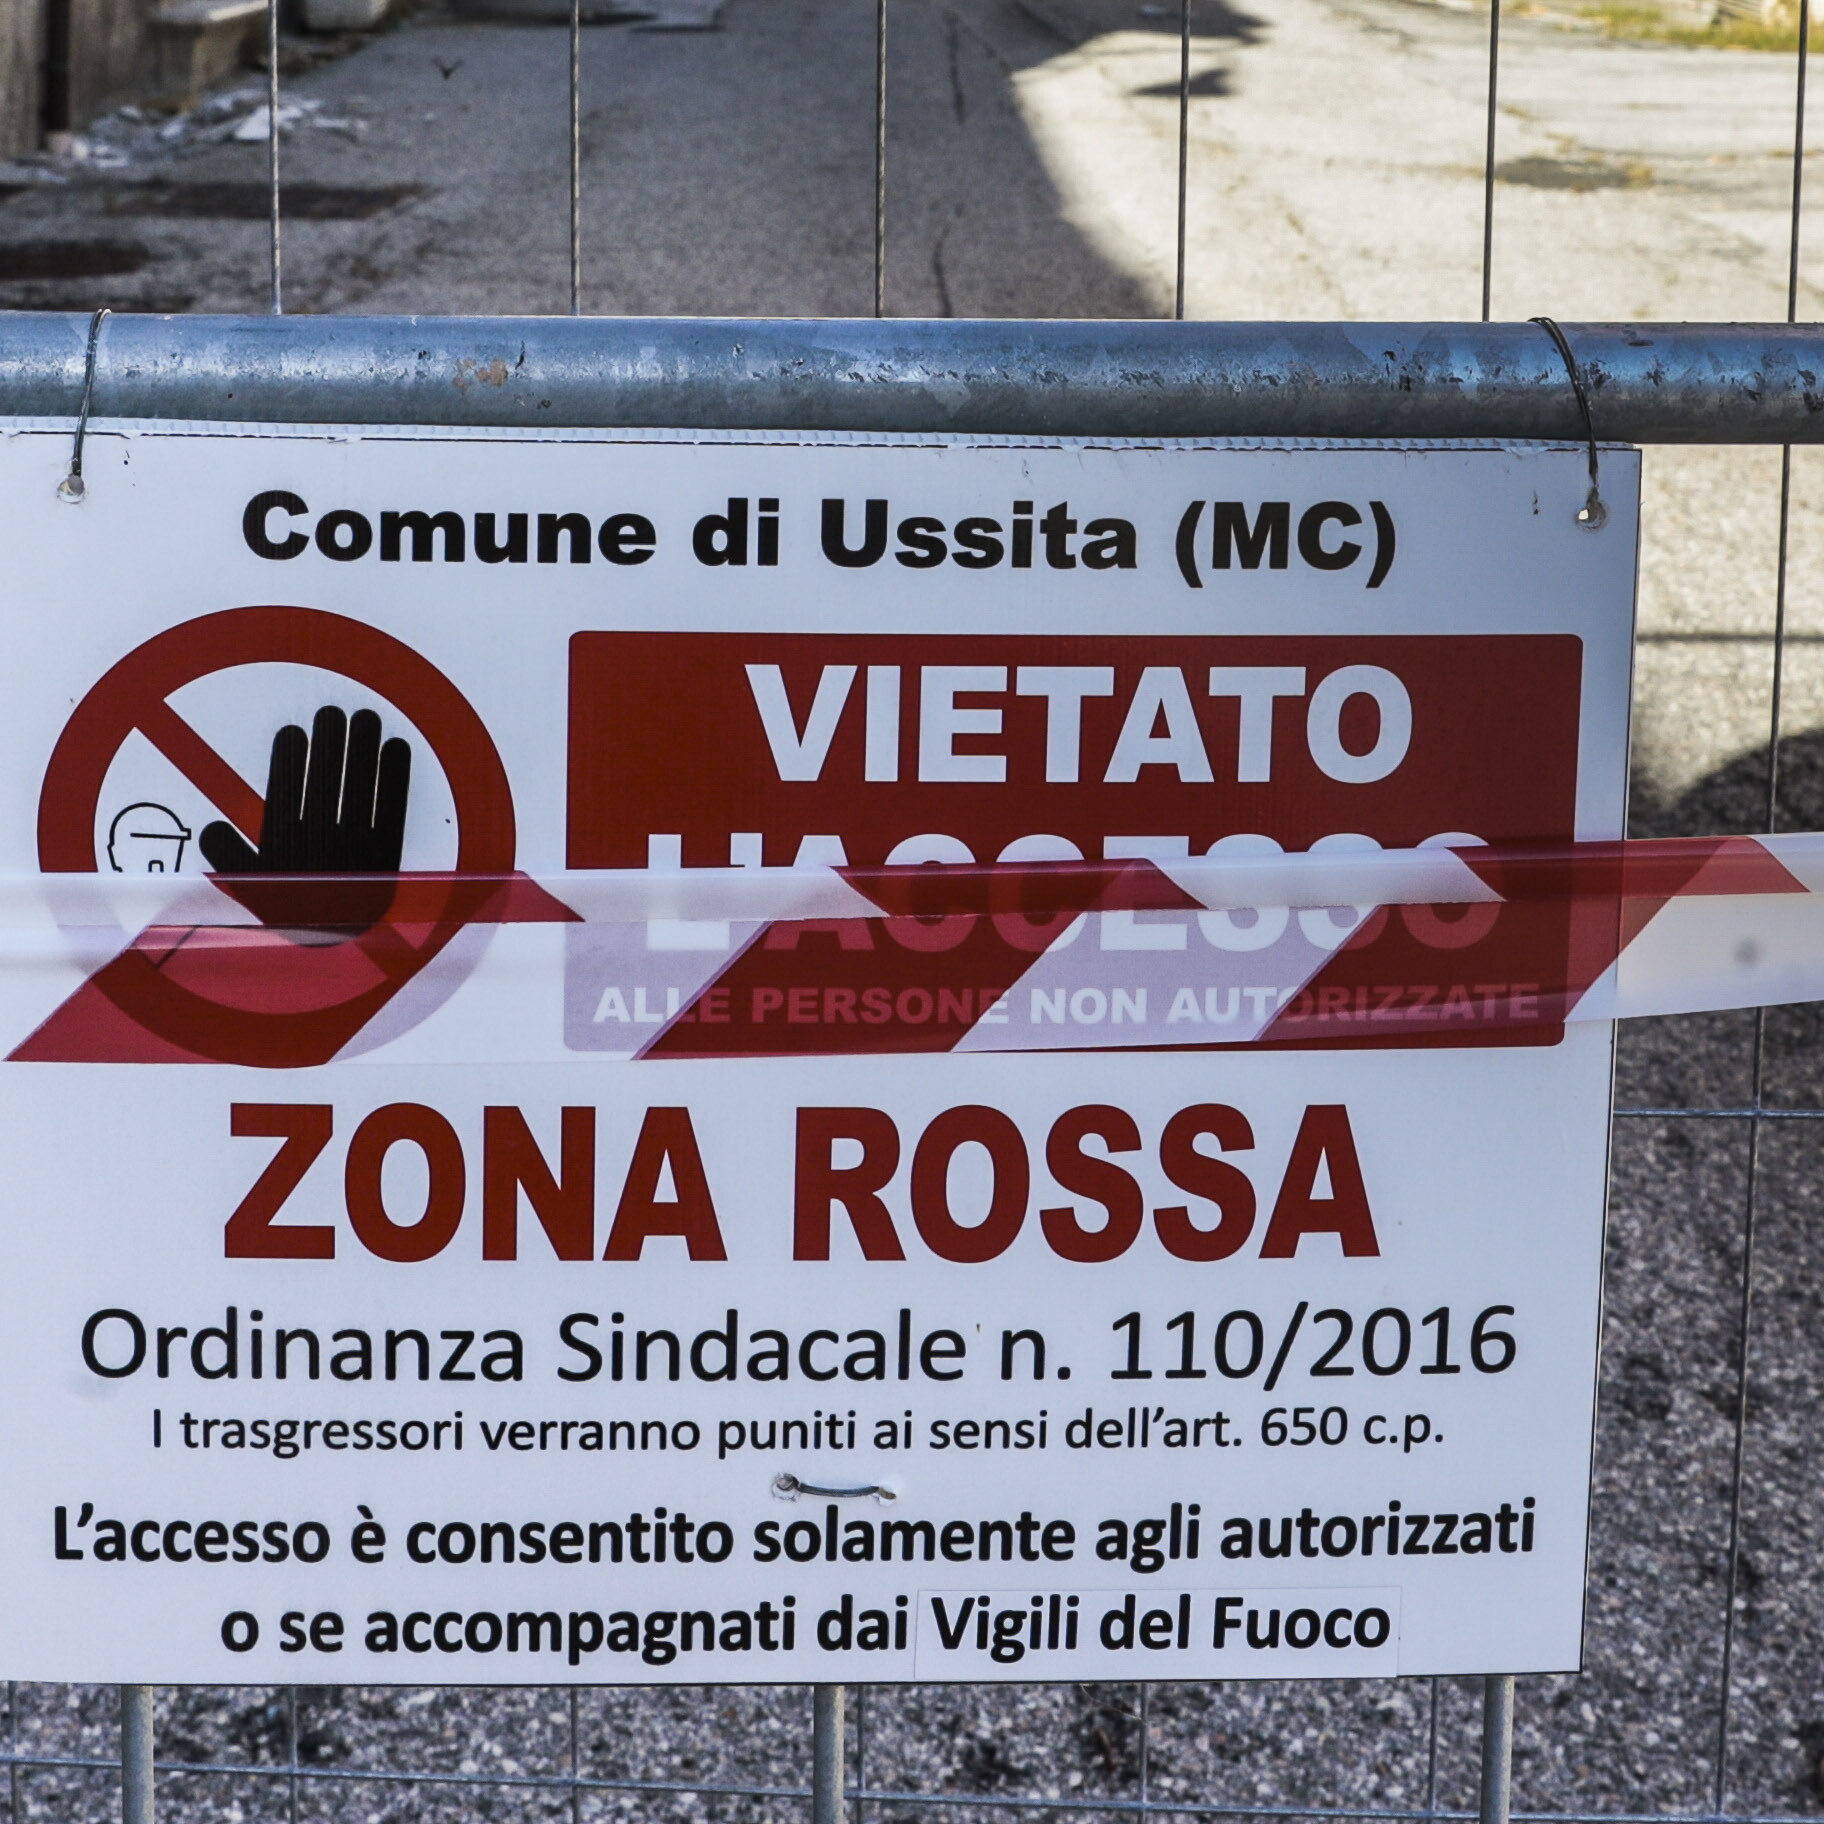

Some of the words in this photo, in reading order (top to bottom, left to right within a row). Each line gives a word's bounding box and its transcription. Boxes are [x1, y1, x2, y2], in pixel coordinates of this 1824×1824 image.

[243, 490, 656, 565] Comune
[693, 498, 779, 566] di
[821, 499, 1137, 569] Ussita
[1176, 501, 1397, 589] (MC)
[745, 664, 1413, 784] VIETATO
[593, 986, 731, 1024] ALLE
[751, 985, 1010, 1025] PERSONE
[1029, 984, 1148, 1024] NON
[1163, 982, 1541, 1024] AUTORIZZATE
[225, 1103, 727, 1262] ZONA
[793, 1103, 1380, 1263] ROSSA
[80, 1306, 523, 1382] Ordinanza
[558, 1308, 964, 1382] Sindacale
[1001, 1329, 1071, 1381] n.
[1110, 1300, 1517, 1388] 110/2016
[152, 1409, 162, 1448] I
[180, 1410, 463, 1460] trasgressori
[480, 1420, 701, 1451] verranno
[718, 1409, 856, 1460] puniti
[873, 1409, 913, 1450] ai
[930, 1409, 1048, 1450] sensi
[1261, 1405, 1347, 1447] 650
[1363, 1413, 1444, 1454] c.p.
[351, 1504, 385, 1564] è
[407, 1506, 734, 1564] consentito
[753, 1504, 1076, 1563] solamente
[1095, 1501, 1201, 1575] agli
[1220, 1497, 1536, 1560] autorizzati
[221, 1611, 259, 1653] o
[280, 1611, 345, 1653] se
[364, 1595, 796, 1667] accompagnati
[816, 1593, 909, 1652] dai
[930, 1593, 1080, 1665] Vigili
[1099, 1593, 1191, 1651] del
[1212, 1596, 1392, 1650] Fuoco
